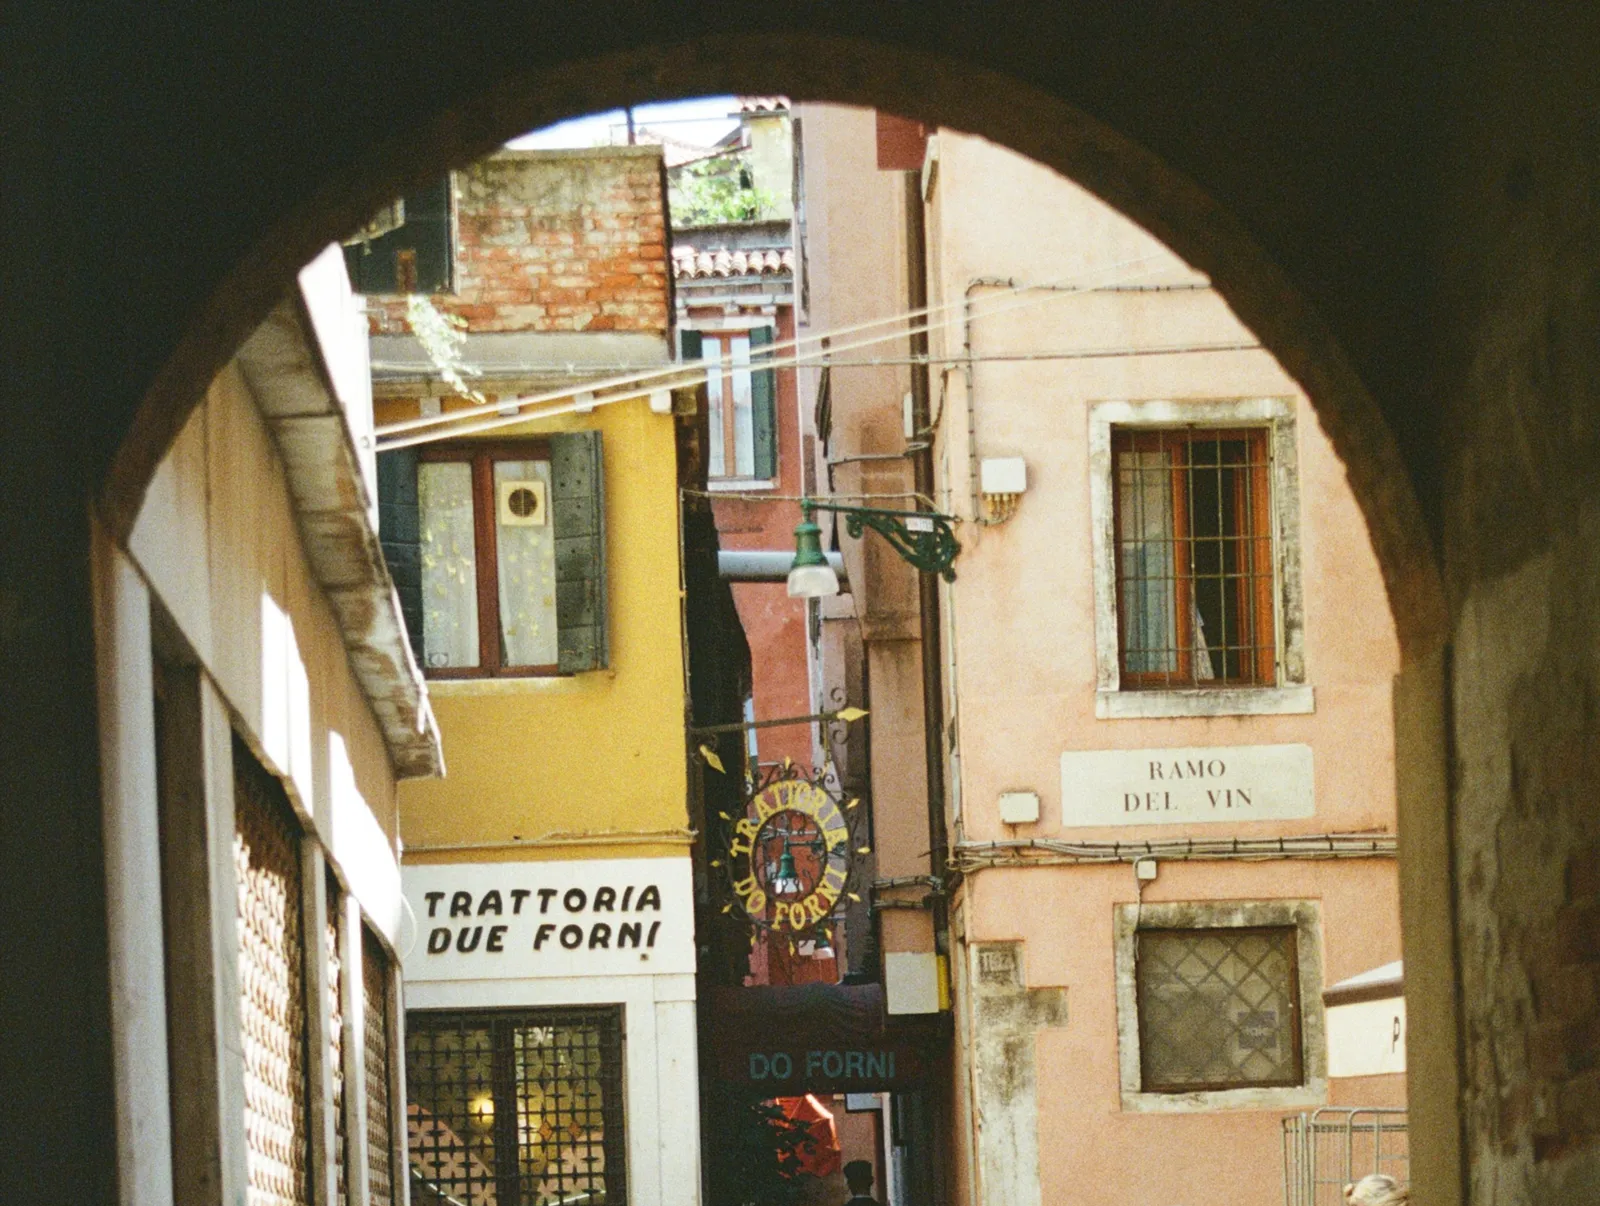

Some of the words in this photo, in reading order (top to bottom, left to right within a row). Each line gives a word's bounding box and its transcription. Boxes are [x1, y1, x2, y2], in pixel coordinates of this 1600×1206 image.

[1149, 759, 1226, 780] RAMO
[730, 779, 848, 854] TRATTORIA
[1124, 791, 1178, 812] DEL
[1206, 788, 1252, 808] VIN
[424, 885, 661, 918] TRATTORIA
[771, 864, 848, 931] FORNI
[427, 925, 508, 954] DUE
[533, 921, 661, 950] FORNI
[750, 1052, 793, 1079] DO
[806, 1050, 895, 1079] FORNI
